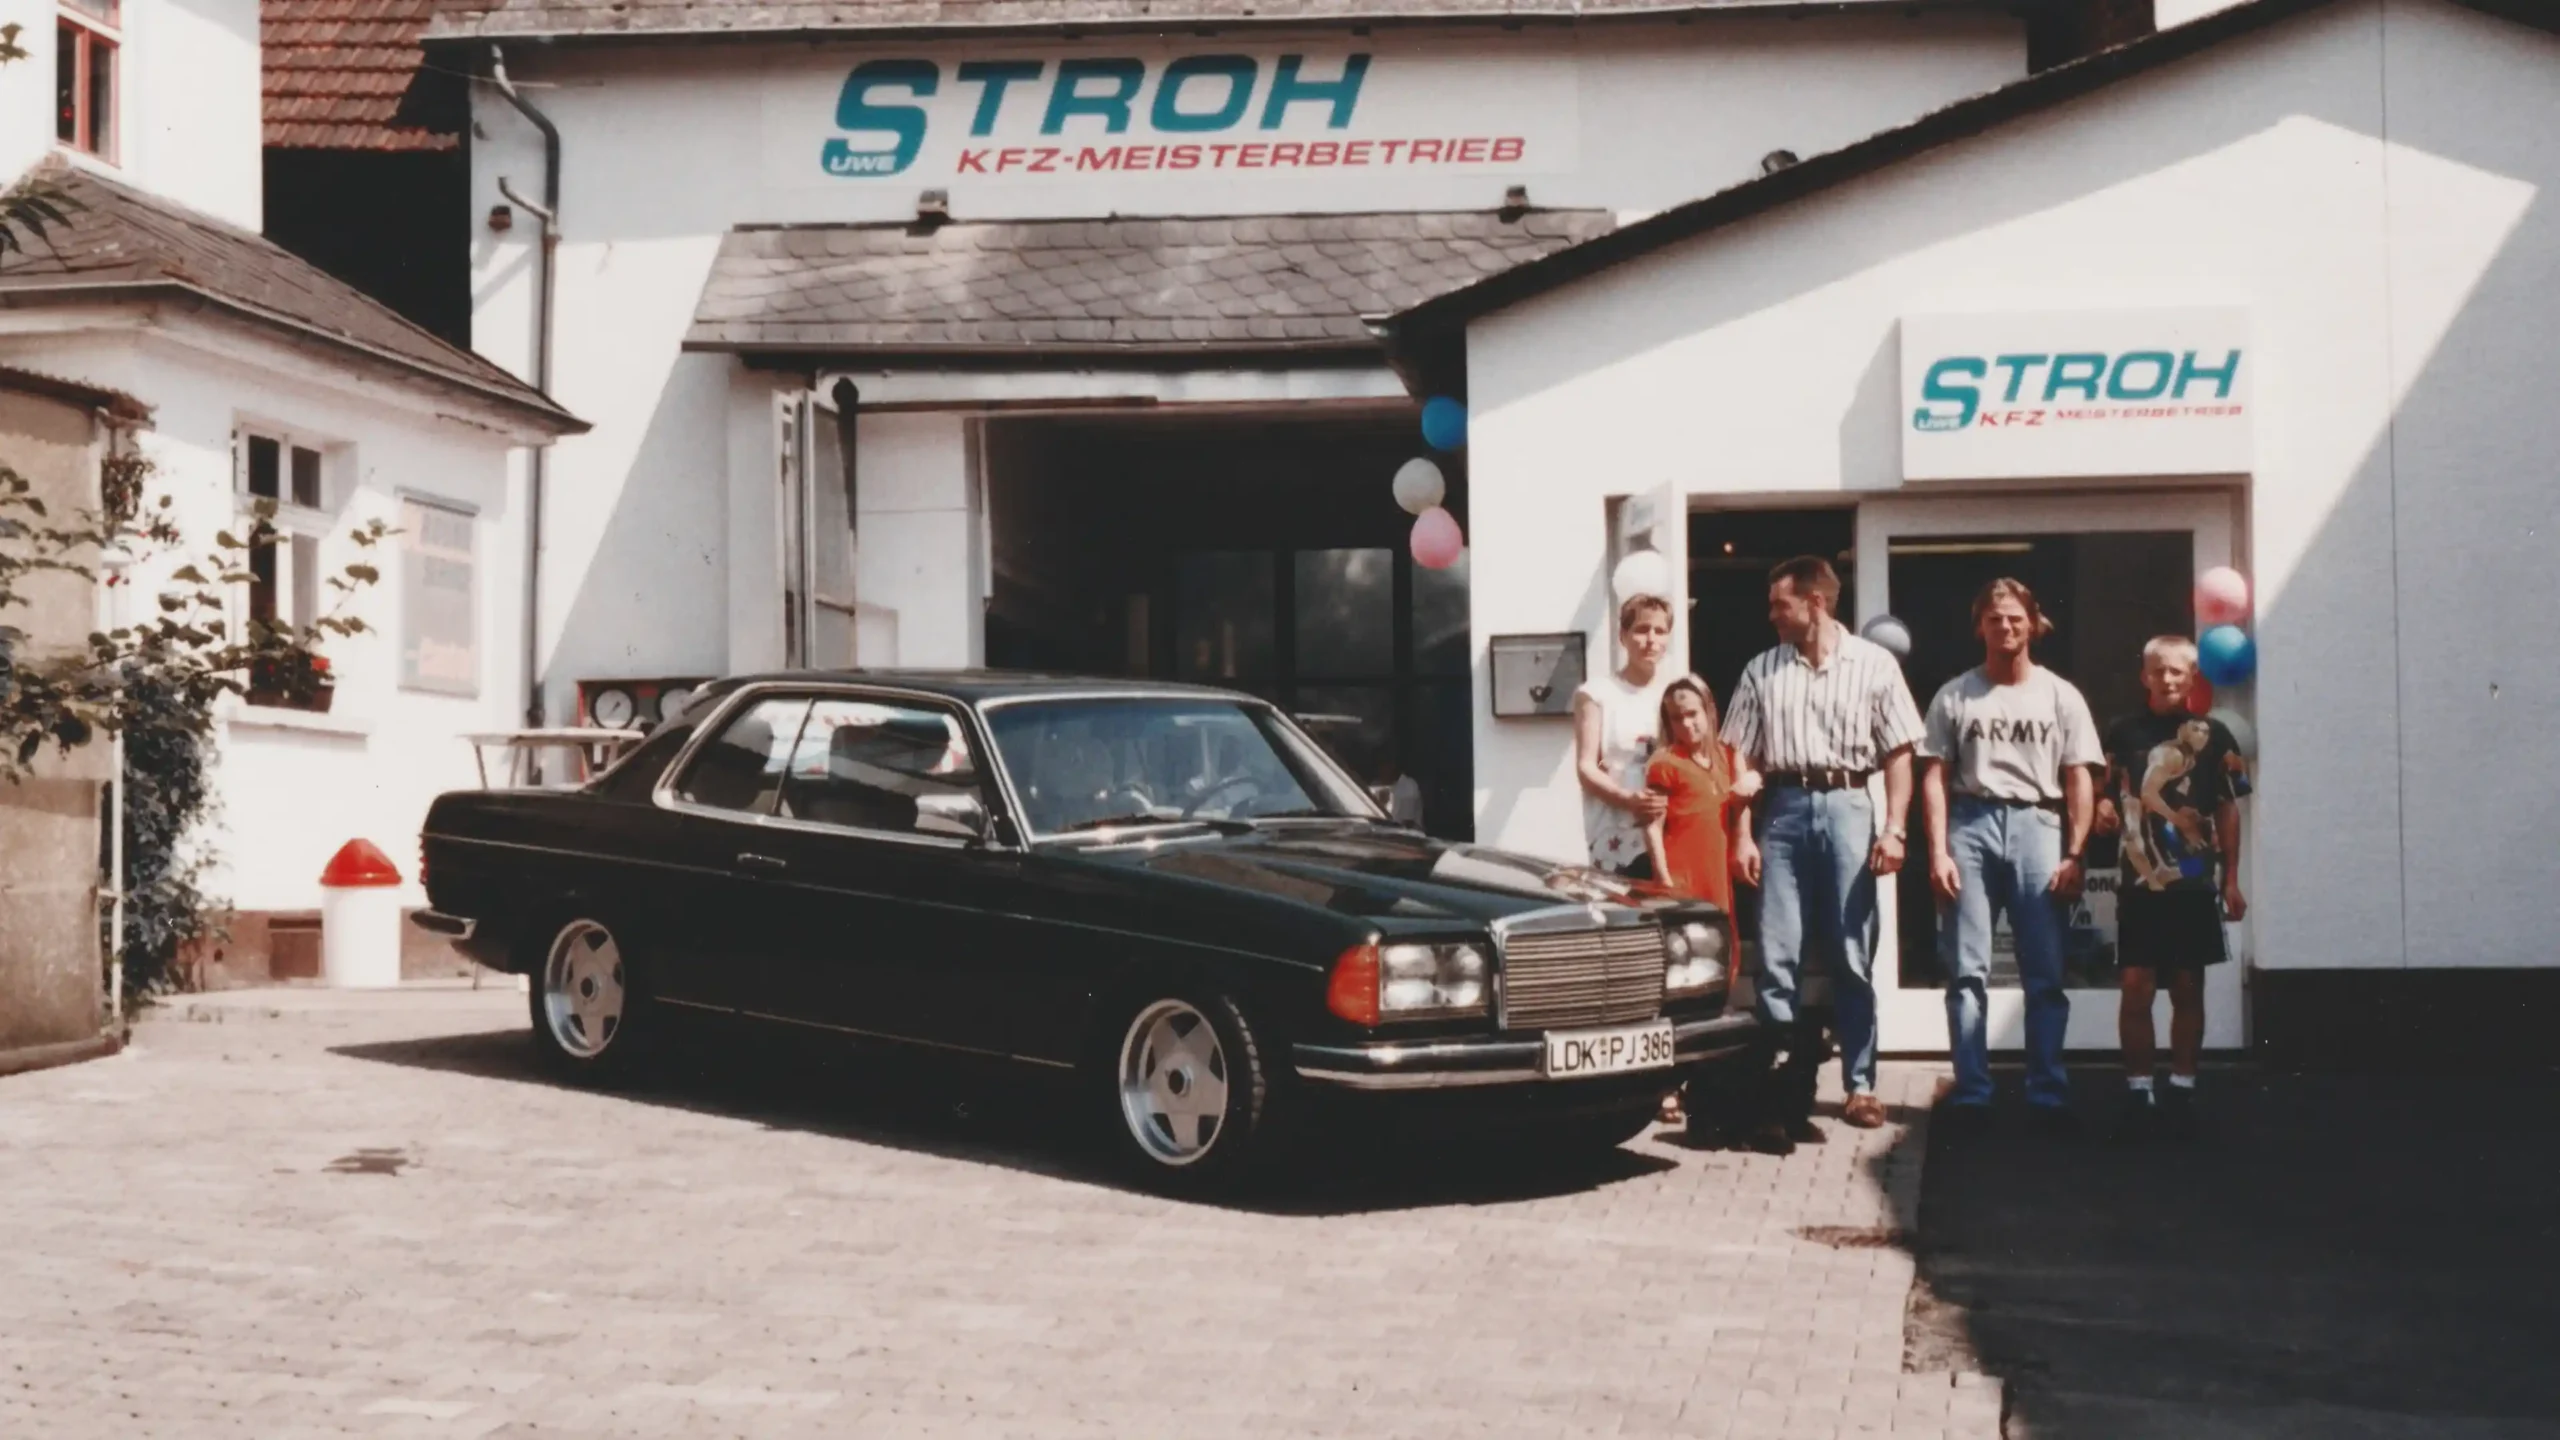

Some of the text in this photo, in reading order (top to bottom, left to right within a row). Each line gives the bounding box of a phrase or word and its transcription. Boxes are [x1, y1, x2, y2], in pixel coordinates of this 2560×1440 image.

[820, 53, 1372, 178] STROH
[956, 137, 1527, 175] KFZ-MEISTERBETRIEB
[1912, 349, 2242, 431] STROH
[1979, 409, 2046, 427] KFZ
[1964, 718, 2053, 744] ARMY
